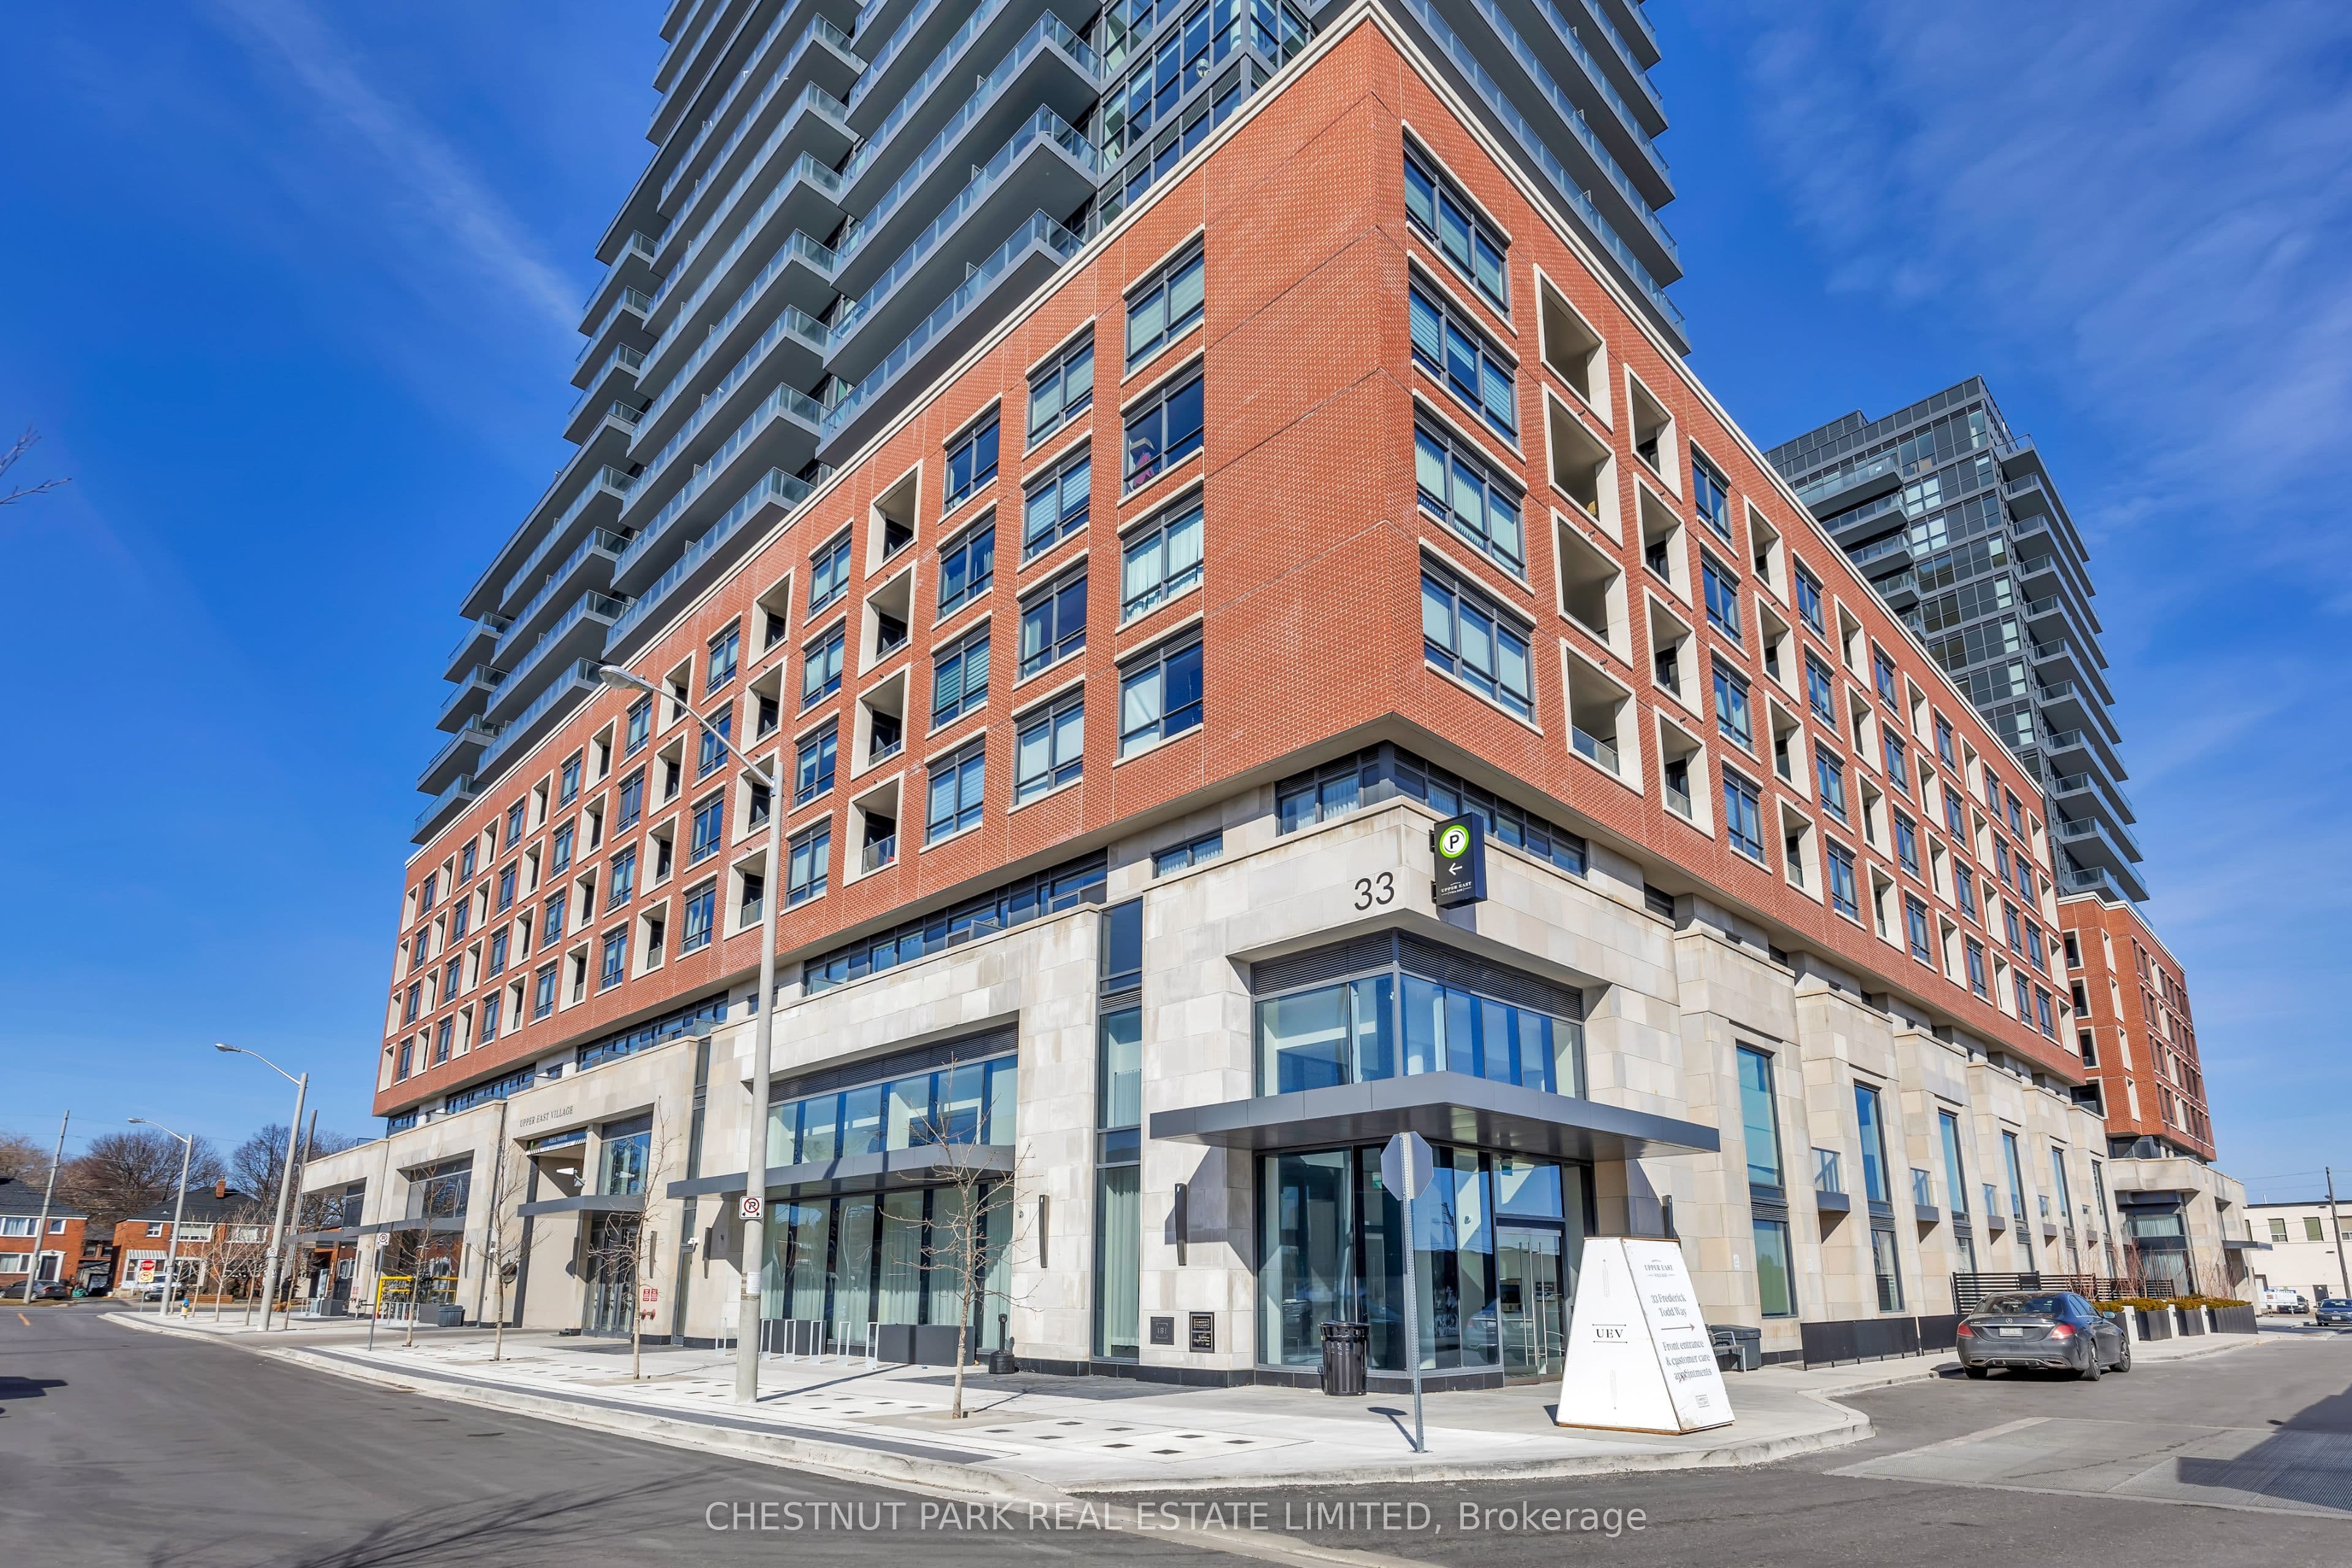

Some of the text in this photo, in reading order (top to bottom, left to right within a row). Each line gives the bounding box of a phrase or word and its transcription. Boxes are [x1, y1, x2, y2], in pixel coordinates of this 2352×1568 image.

[1450, 834, 1460, 850] P
[1354, 872, 1395, 911] 33
[520, 1106, 573, 1127] UPPER EAST VILLAGE
[1651, 1293, 1686, 1303] 33 Frederick
[1659, 1306, 1687, 1317] Todd Way
[1596, 1329, 1623, 1338] UEV
[1663, 1341, 1705, 1351] Front entrance
[1666, 1356, 1672, 1366] &
[1671, 1355, 1698, 1365] customer
[1674, 1368, 1713, 1383] appointments
